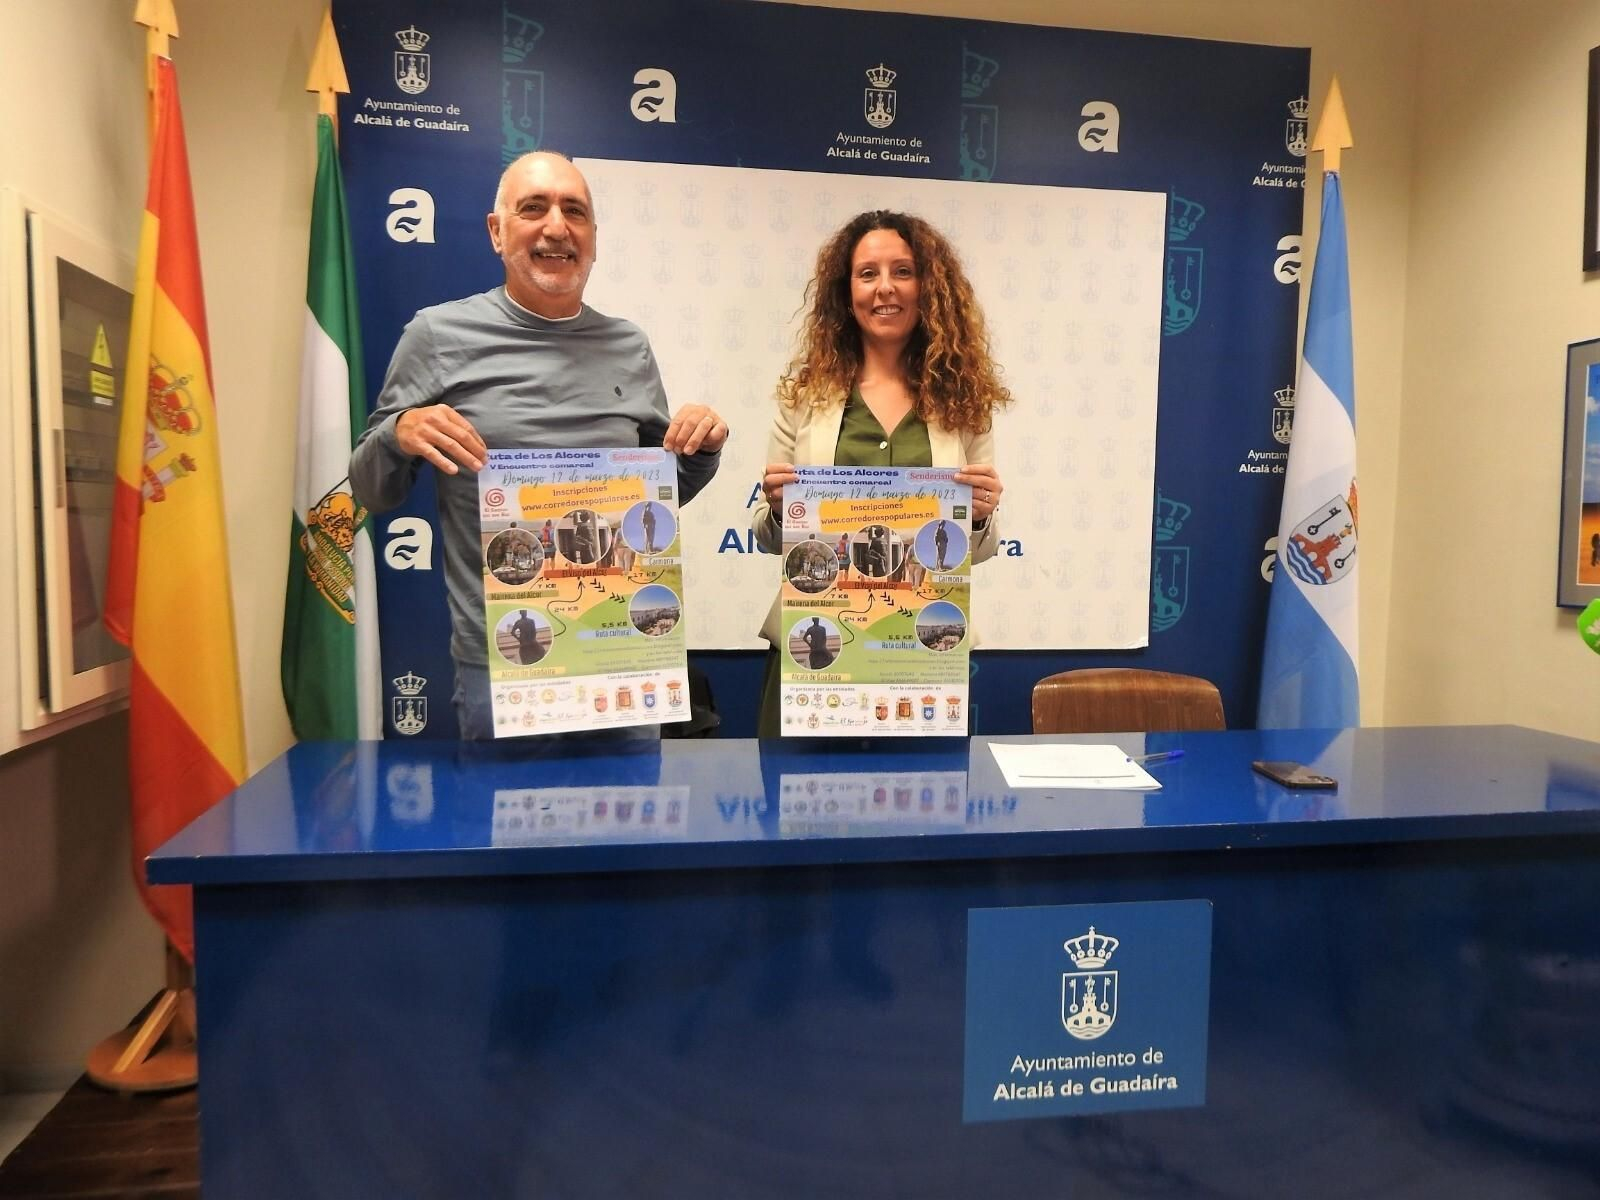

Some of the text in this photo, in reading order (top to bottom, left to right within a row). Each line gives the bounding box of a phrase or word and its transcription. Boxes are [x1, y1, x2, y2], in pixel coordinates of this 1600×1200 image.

[364, 97, 461, 115] Ayuntamiento de
[354, 113, 393, 126] Alcalá
[396, 117, 411, 128] de
[836, 131, 922, 148] Ayuntamiento de
[826, 147, 931, 164] Alcalá de Guadaíra
[1252, 176, 1284, 187] Alcalá
[1286, 178, 1298, 188] de
[532, 452, 553, 460] Los
[555, 451, 600, 459] Alcores
[1239, 463, 1285, 474] Alcalá de
[502, 471, 545, 489] Domingo
[569, 469, 579, 484] de
[553, 485, 608, 497] Inscripciones
[805, 486, 956, 503] Domingo 12 de marzo de 2023
[522, 494, 640, 511] www.corredorespopulares.es
[851, 503, 903, 512] Inscripciones
[821, 511, 934, 525] www.corredorespopulares.es
[938, 575, 963, 583] Carmona
[1010, 1047, 1164, 1077] Ayuntamiento de
[993, 1074, 1178, 1101] Alcalá de Guadaíra
